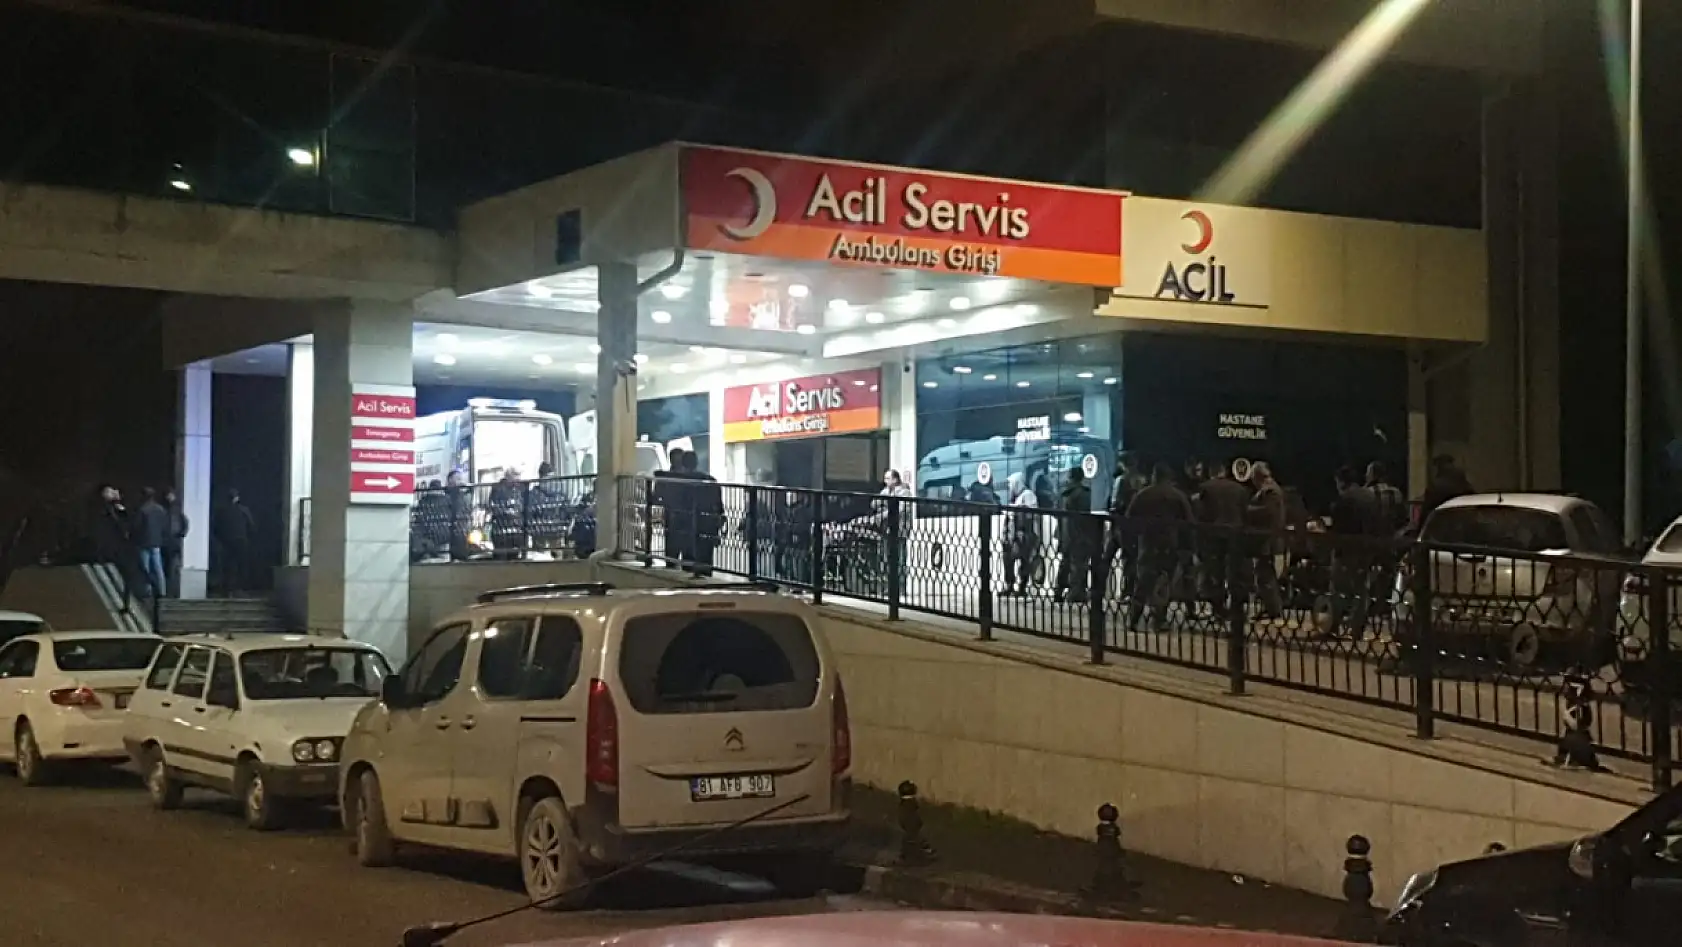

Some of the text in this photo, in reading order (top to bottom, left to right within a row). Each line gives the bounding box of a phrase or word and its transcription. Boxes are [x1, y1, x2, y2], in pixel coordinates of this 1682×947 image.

[806, 172, 1030, 239] Acil Servis
[831, 233, 1001, 276] Ambulans Girişi
[1154, 254, 1235, 302] ACİL
[357, 400, 411, 414] Acil Servis
[747, 377, 843, 418] Acil Servis
[1219, 413, 1265, 426] HASTANE
[699, 777, 712, 793] 81
[749, 774, 770, 791] 907
